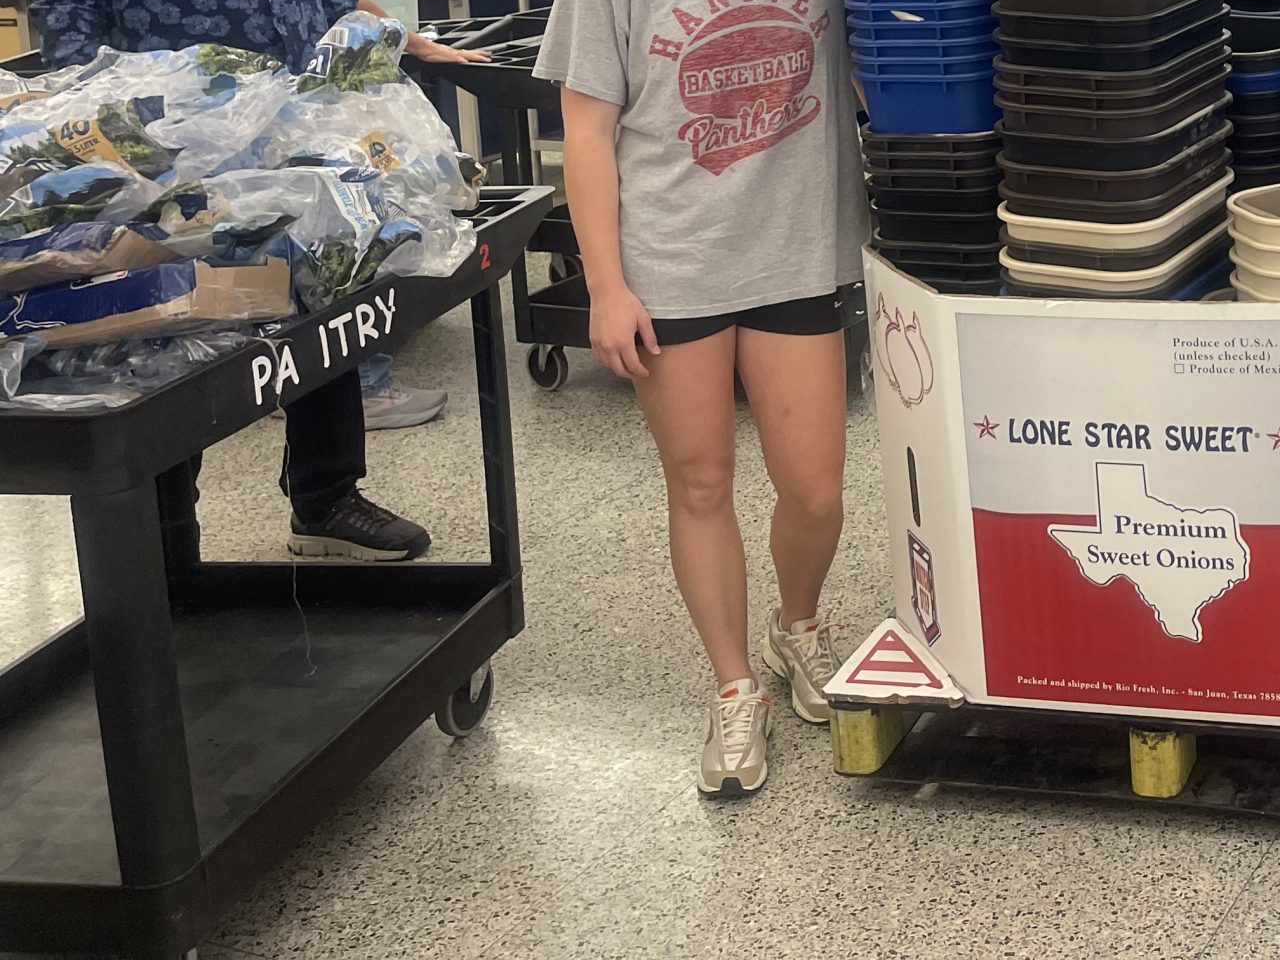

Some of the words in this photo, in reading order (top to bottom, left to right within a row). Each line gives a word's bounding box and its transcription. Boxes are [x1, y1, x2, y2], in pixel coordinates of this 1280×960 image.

[684, 50, 812, 96] BASKETBALL
[678, 94, 822, 161] Panthers
[479, 244, 491, 270] 2
[1173, 337, 1220, 348] Produce
[1224, 337, 1236, 348] of
[1240, 337, 1278, 348] U.S.A.
[1173, 351, 1214, 362] (unless
[1218, 351, 1271, 362] checked)
[1190, 364, 1235, 374] Produce
[1239, 364, 1250, 374] of
[1008, 418, 1072, 446] LONE
[1085, 422, 1151, 450] STAR
[1114, 515, 1227, 539] Premium
[1087, 544, 1151, 566] Sweet
[1156, 548, 1235, 570] Onions
[1017, 675, 1048, 686] Packed
[1050, 679, 1066, 687] and
[1067, 680, 1100, 690] shipped
[1102, 682, 1113, 692] by
[1162, 686, 1180, 695] Inc.
[1188, 688, 1204, 697] San
[1206, 690, 1230, 699] Juan,
[1232, 691, 1257, 700] Texas
